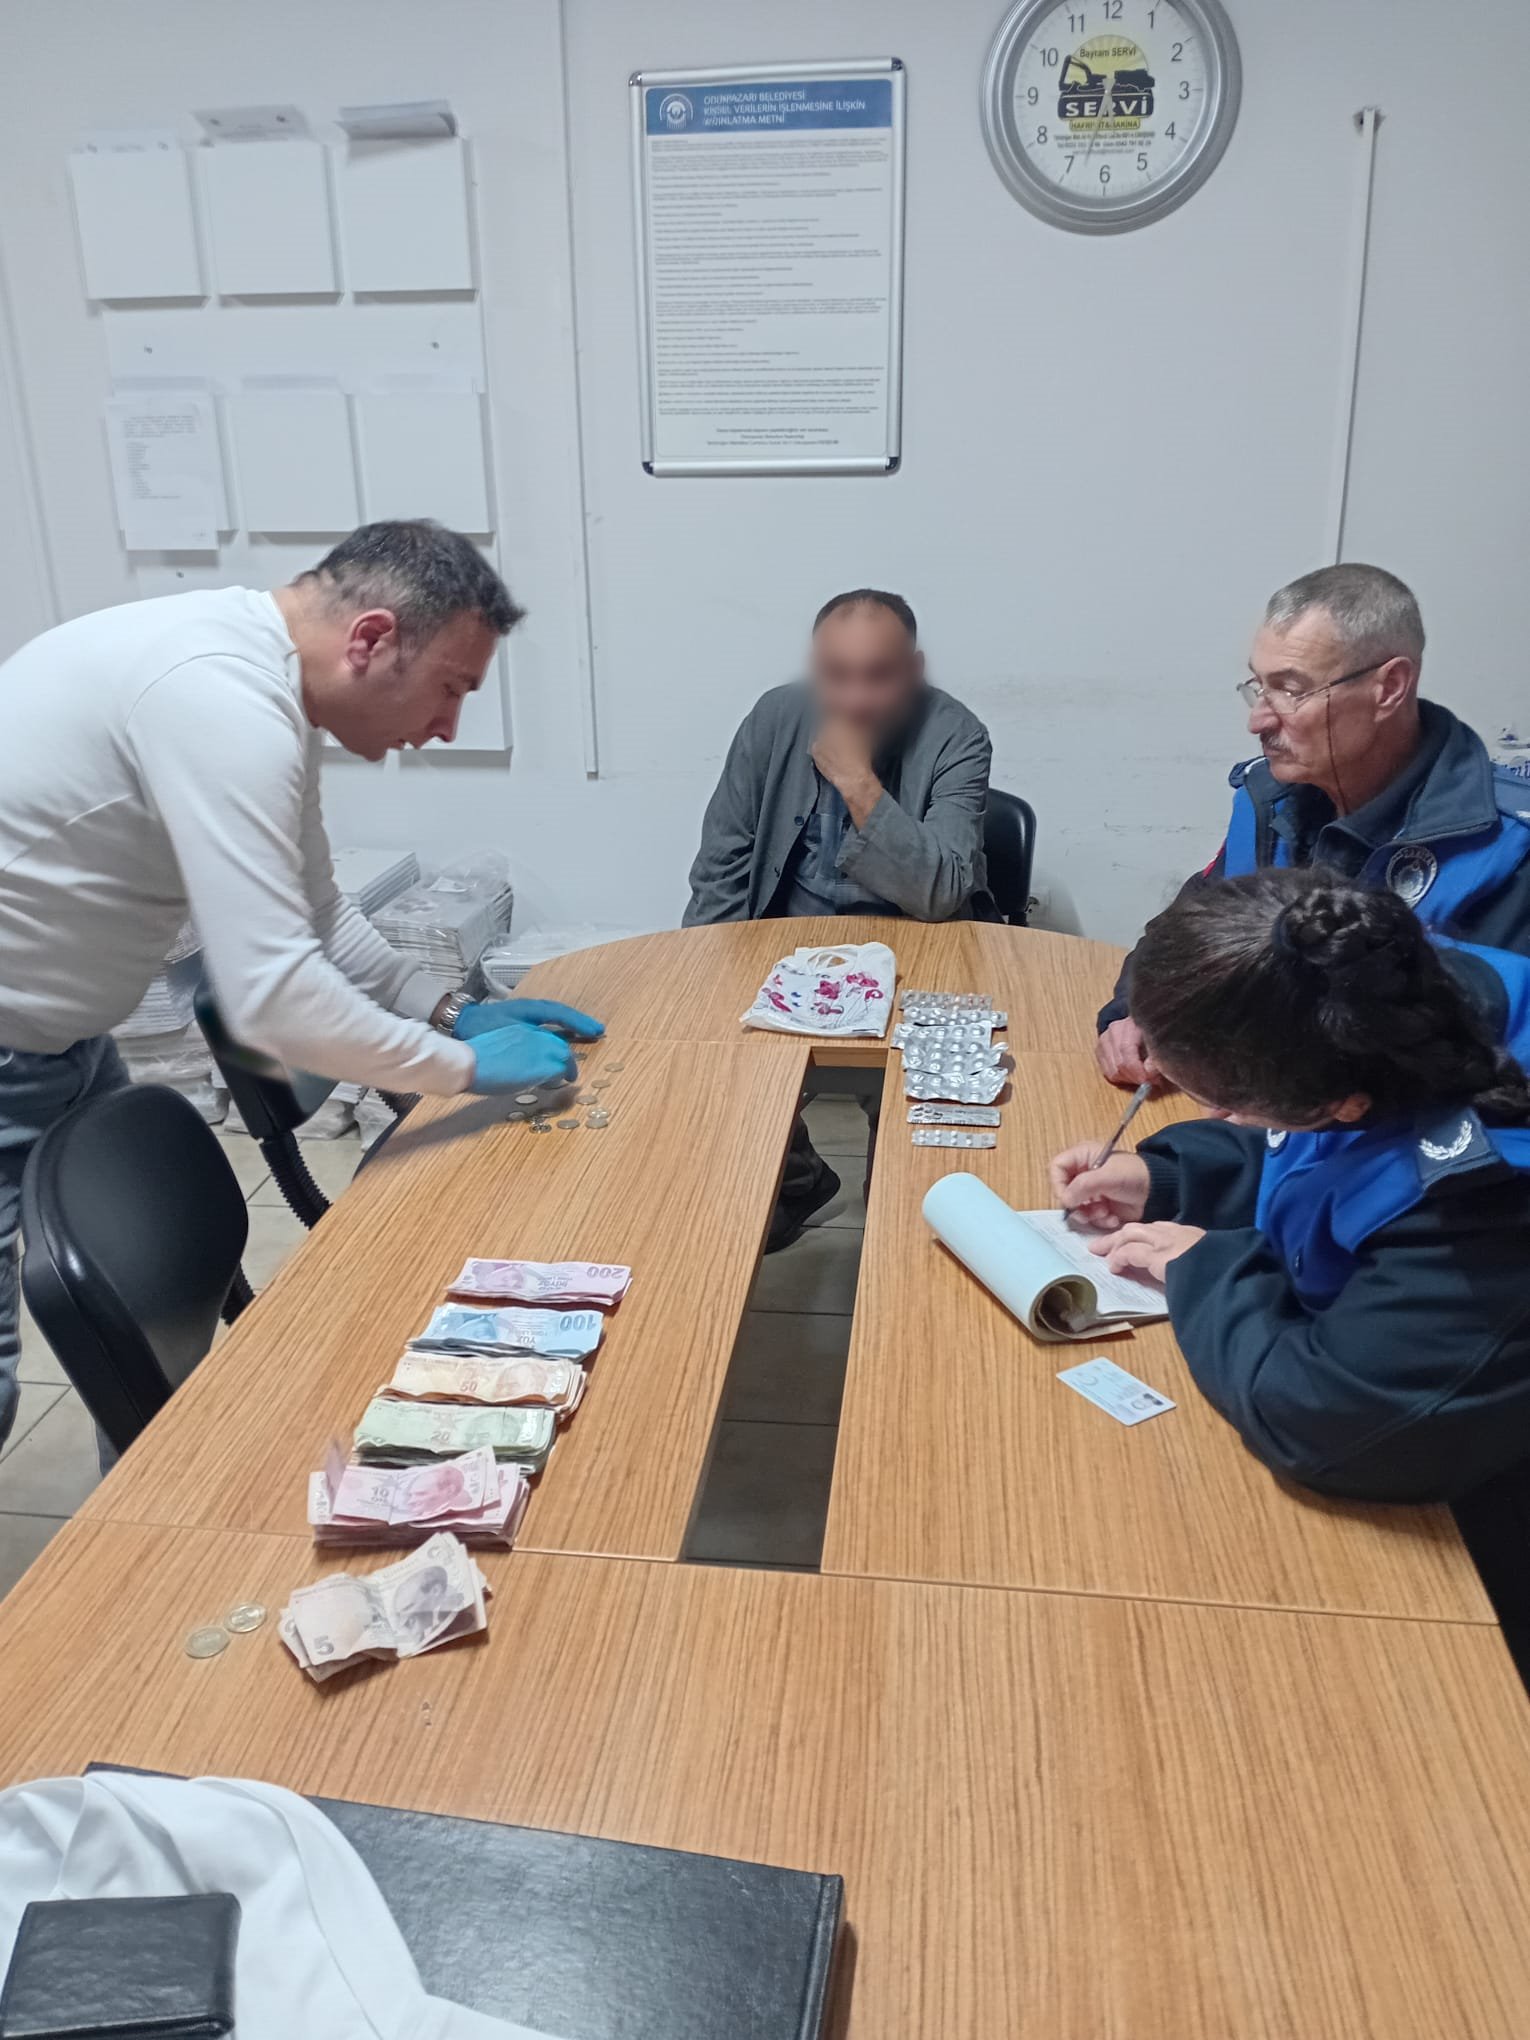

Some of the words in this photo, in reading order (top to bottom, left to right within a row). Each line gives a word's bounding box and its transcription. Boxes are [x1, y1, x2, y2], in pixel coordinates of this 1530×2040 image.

[1103, 0, 1122, 19] 12
[1068, 14, 1084, 33] 11
[1147, 11, 1154, 29] 1
[1040, 48, 1058, 67] 10
[1080, 48, 1109, 59] Bayram
[1171, 43, 1183, 62] 2
[703, 93, 757, 105] ODUNPAZARI
[759, 89, 805, 102] BELEDİYESİ
[1027, 86, 1039, 105] 9
[1178, 81, 1190, 100] 3
[1037, 126, 1048, 144] 8
[1165, 122, 1176, 140] 4
[1064, 155, 1075, 173] 7
[1137, 153, 1148, 171] 5
[1100, 165, 1111, 183] 6
[587, 1266, 625, 1279] 200
[560, 1315, 597, 1332] 100
[460, 1381, 478, 1392] 50
[431, 1431, 451, 1441] 20
[313, 1635, 335, 1656] 5
